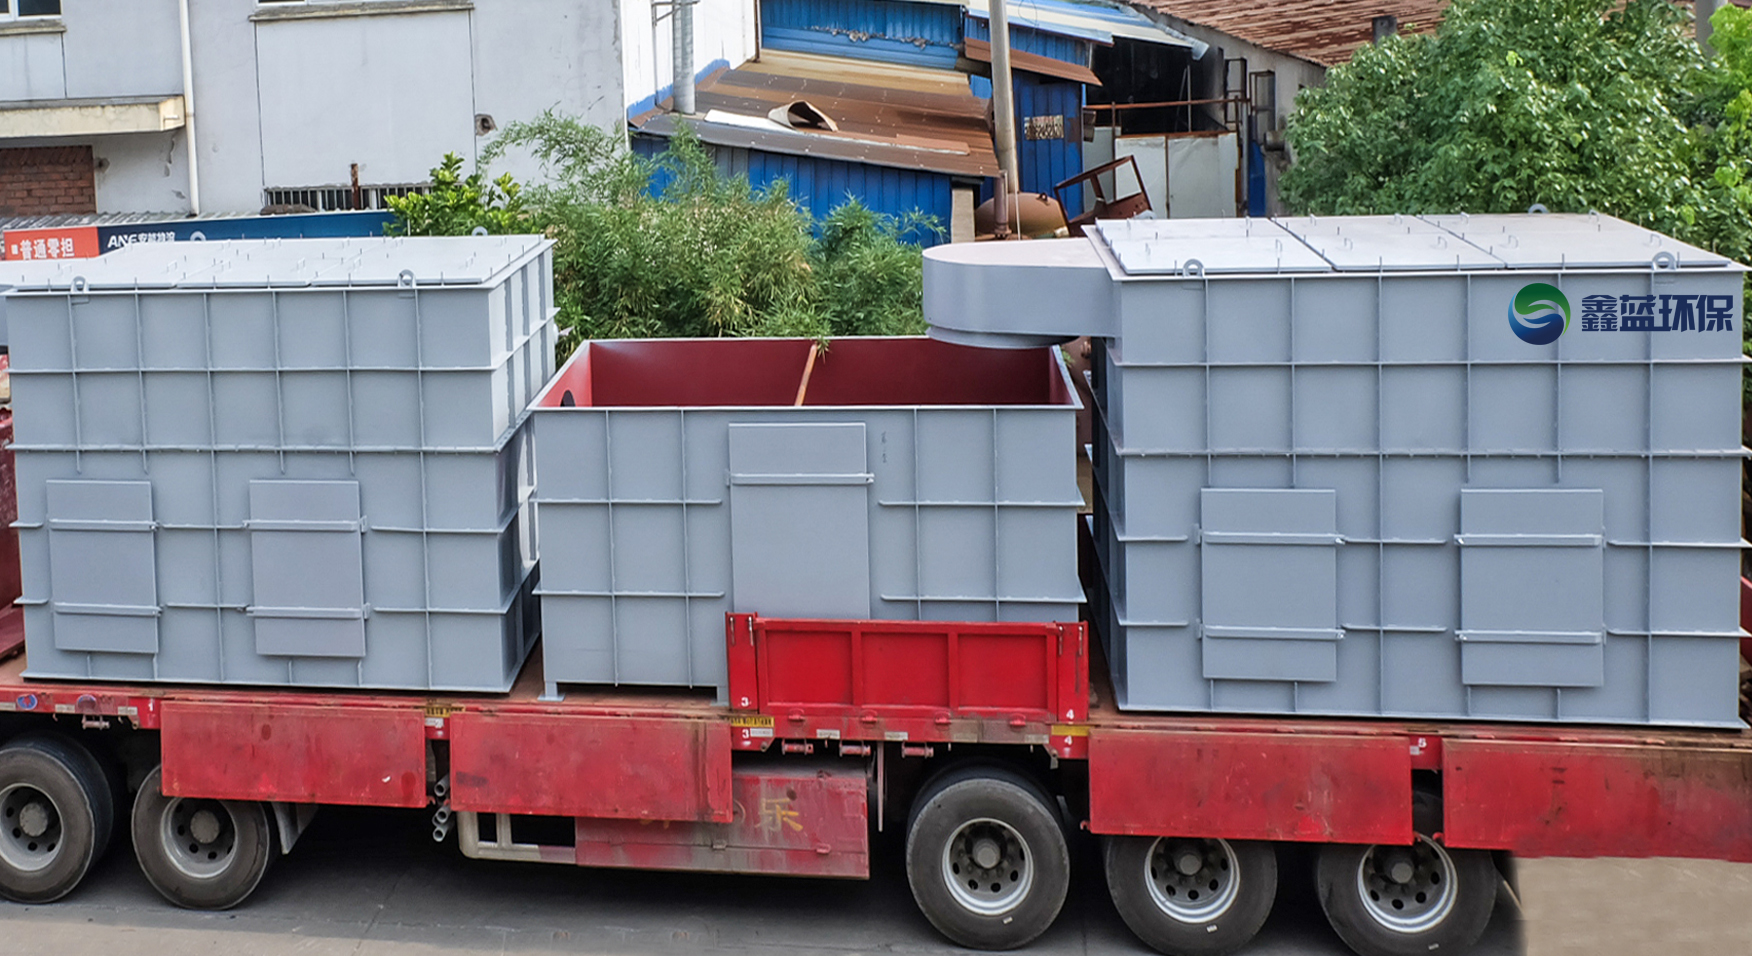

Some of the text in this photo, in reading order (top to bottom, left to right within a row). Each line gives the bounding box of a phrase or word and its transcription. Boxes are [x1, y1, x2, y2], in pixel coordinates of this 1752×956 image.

[20, 238, 75, 260] 普通零担
[741, 697, 749, 707] 3
[1066, 709, 1074, 719] 4
[742, 729, 749, 738] 3
[1064, 735, 1072, 745] 4
